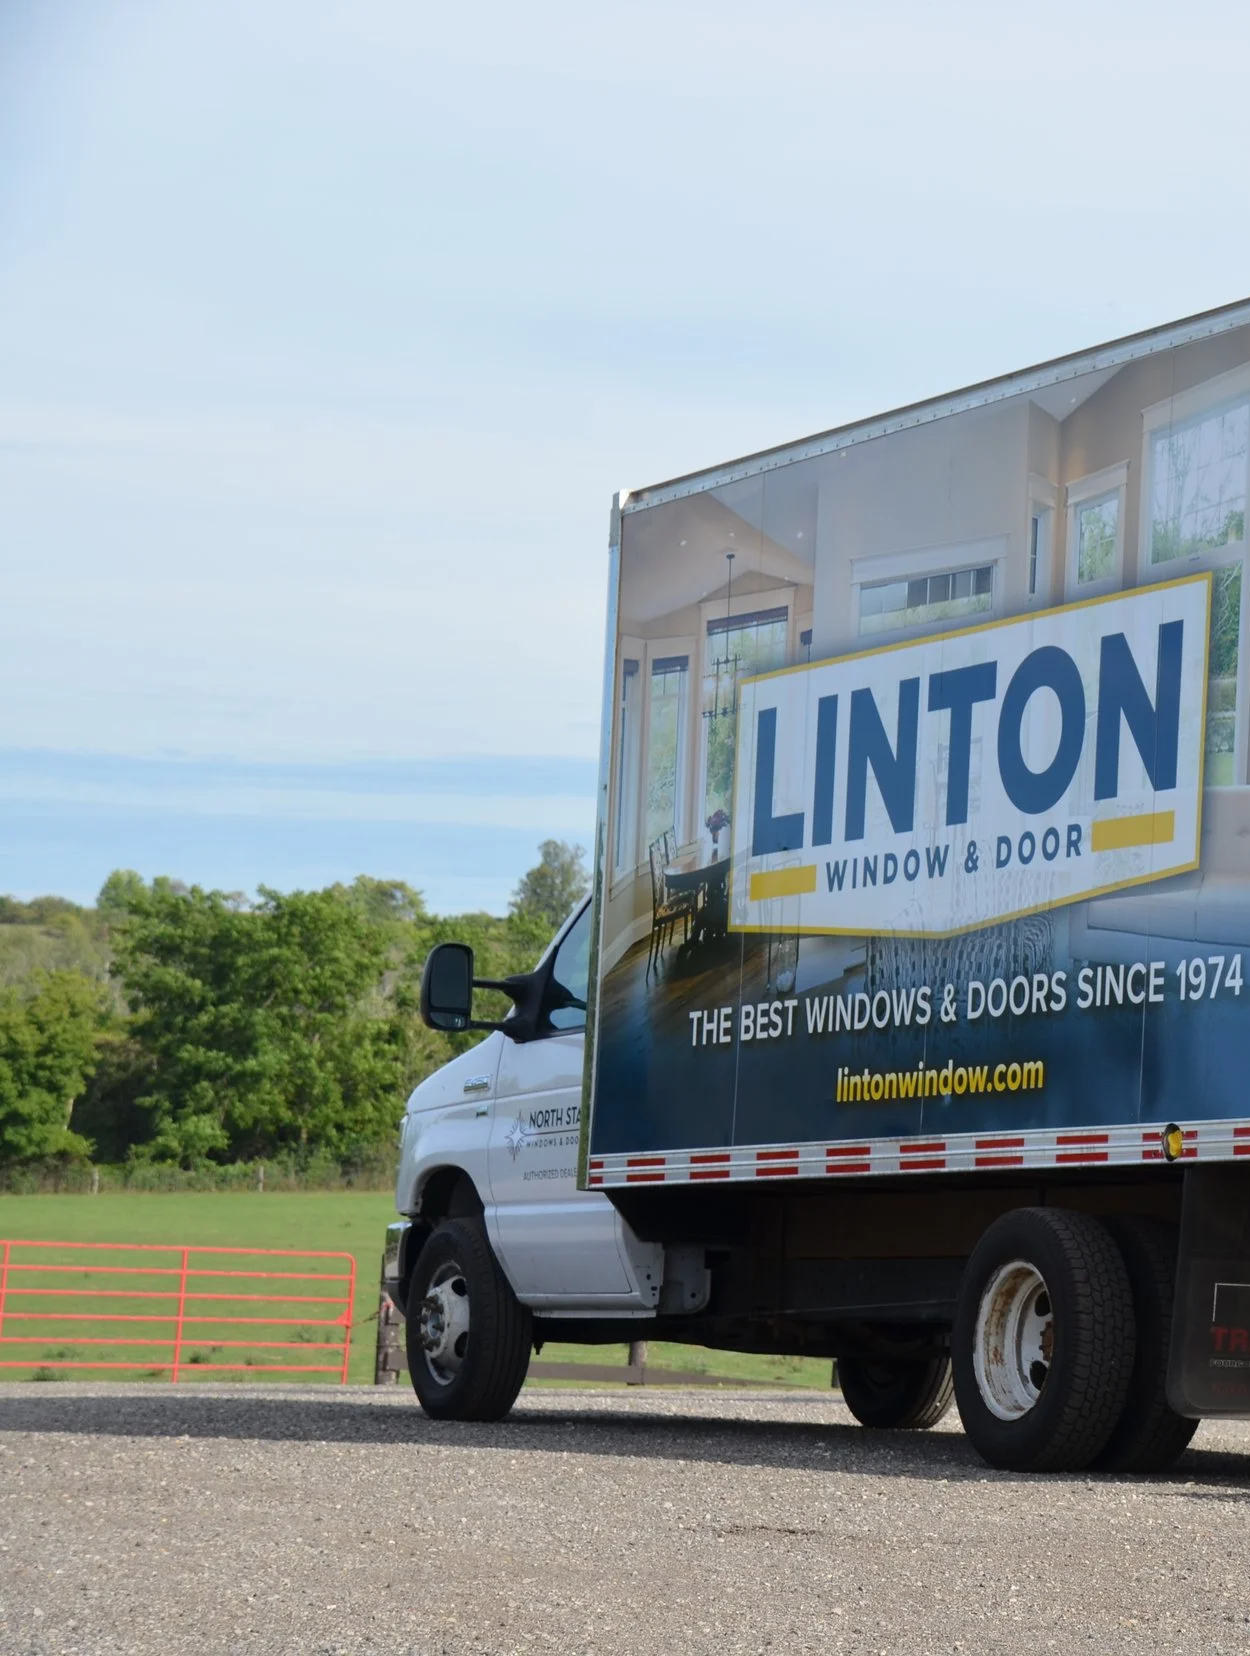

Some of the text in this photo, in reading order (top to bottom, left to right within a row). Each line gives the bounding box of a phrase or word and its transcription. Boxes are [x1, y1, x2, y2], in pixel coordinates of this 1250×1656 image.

[751, 619, 1184, 857] LINTON
[825, 823, 1083, 893] WINDOW & DOOR
[689, 953, 1243, 1046] THE BEST WINDOWS & DOORS SINCE 1974
[836, 1059, 1044, 1103] lintonwindow.com
[529, 1106, 581, 1128] NORTH STA
[566, 1136, 579, 1146] DOO
[560, 1167, 577, 1179] DEALE
